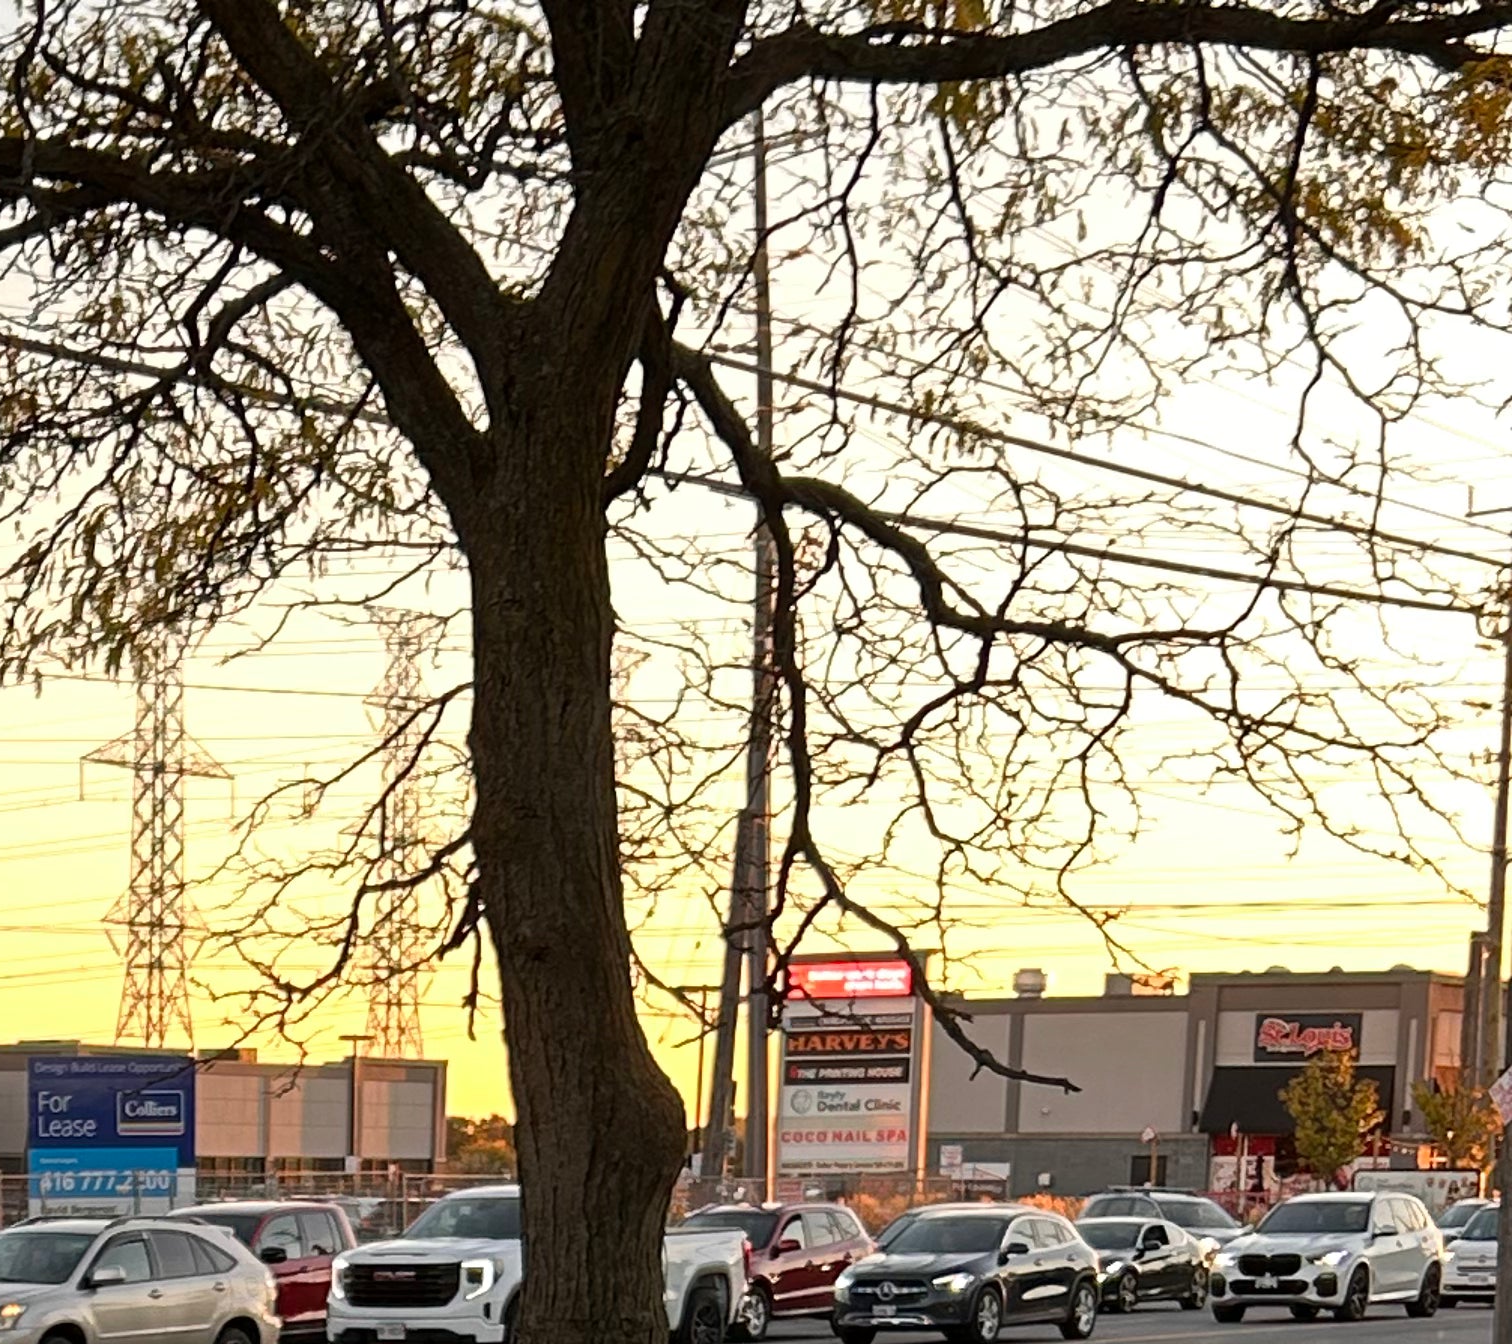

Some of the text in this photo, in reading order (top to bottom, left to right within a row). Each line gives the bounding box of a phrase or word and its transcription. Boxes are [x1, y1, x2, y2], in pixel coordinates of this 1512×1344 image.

[787, 1033, 909, 1051] HARVEY'S
[34, 1062, 68, 1076] Design
[70, 1062, 97, 1073] Build
[98, 1063, 126, 1073] Lease
[38, 1091, 73, 1113] For
[124, 1100, 178, 1117] Colliers
[817, 1099, 902, 1112] Dental Clinic
[38, 1116, 97, 1138] Lease
[781, 1129, 908, 1143] COCO NAIL SPA
